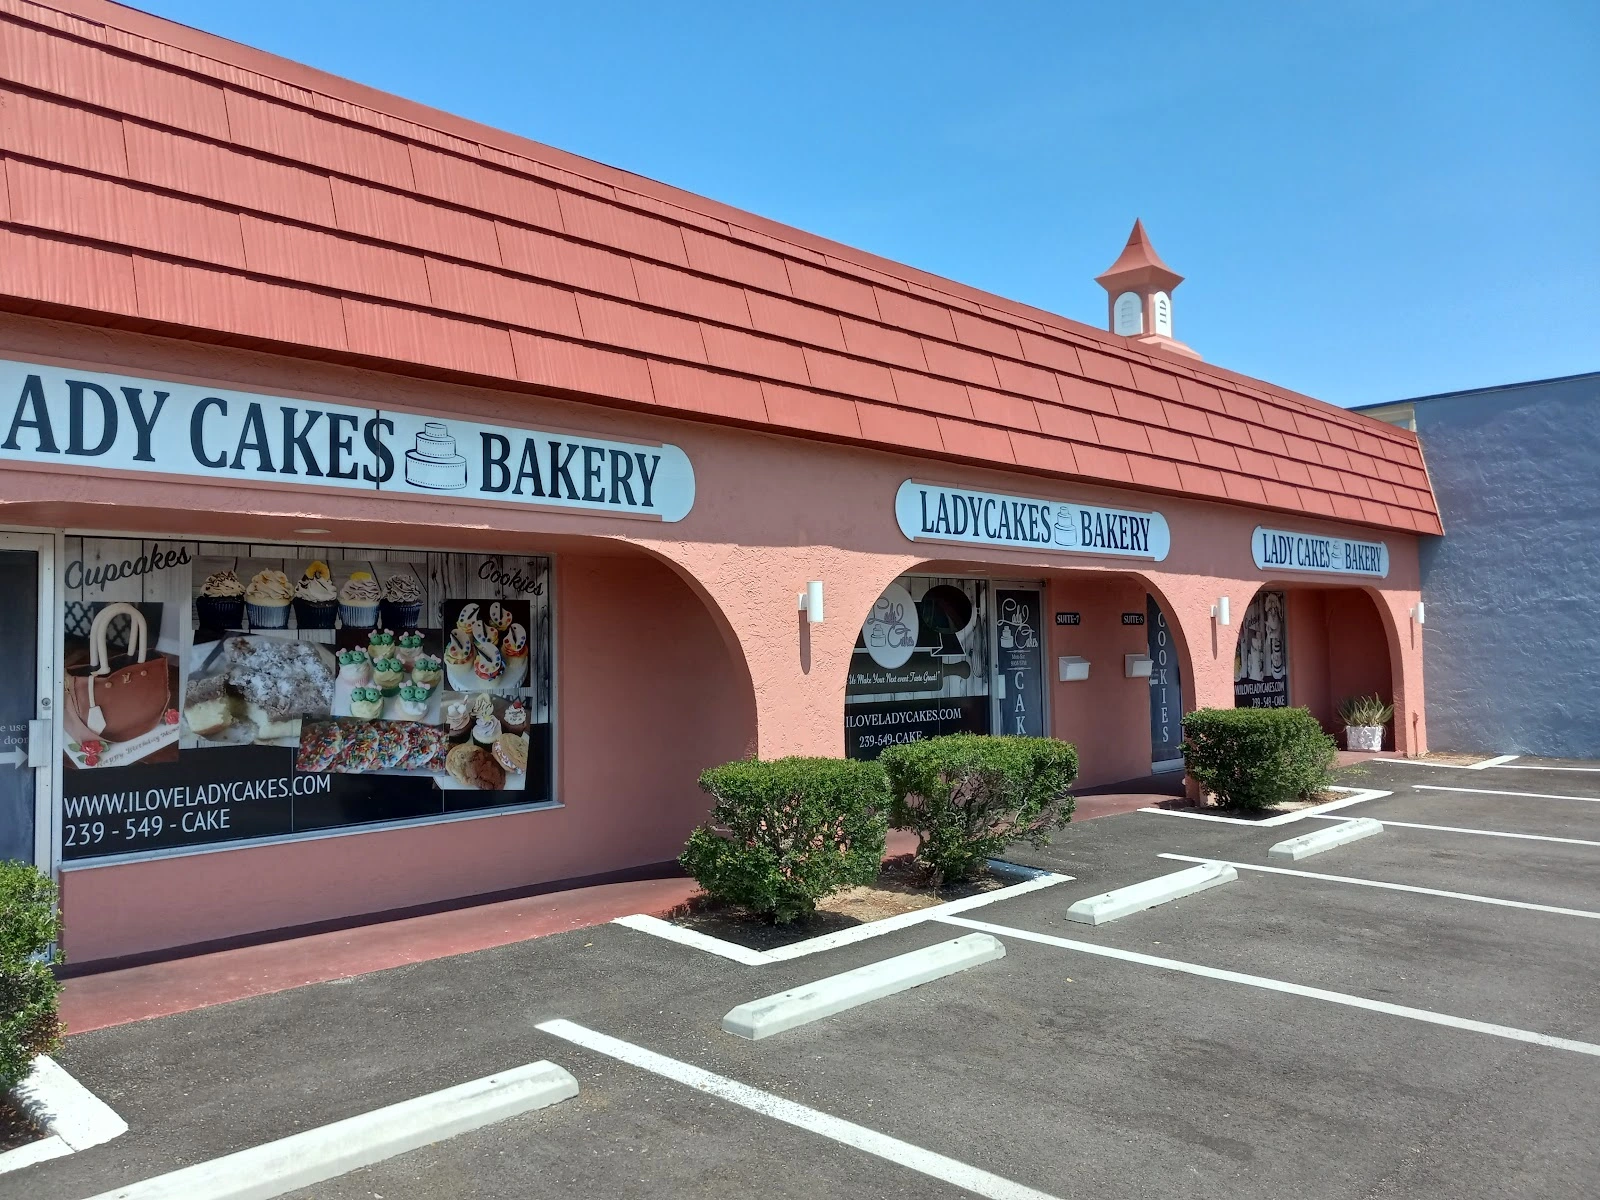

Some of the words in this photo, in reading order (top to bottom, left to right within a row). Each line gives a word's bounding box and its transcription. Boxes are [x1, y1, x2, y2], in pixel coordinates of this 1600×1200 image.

[1, 375, 170, 462] ADY
[190, 397, 395, 483] CAKES
[480, 433, 661, 507] BAKERY
[920, 491, 1051, 543] LADYCAKES
[1080, 510, 1151, 551] BAKERY
[64, 543, 192, 592] Cupcakes
[1263, 534, 1294, 565] LADY
[1297, 538, 1331, 568] CAKES
[1345, 543, 1382, 572] BAKERY
[478, 560, 544, 596] Cookies
[1056, 614, 1080, 624] SUITE-7
[857, 672, 871, 684] Make
[872, 672, 885, 684] Your
[1157, 611, 1169, 743] COOKIES
[846, 708, 962, 728] ILOVELADYCAKES.COM
[3, 735, 28, 745] door
[64, 773, 331, 819] WWW.ILOVELADYCAKES.COM
[64, 821, 105, 847] 239
[126, 815, 163, 840] 549
[181, 809, 231, 833] CAKE
